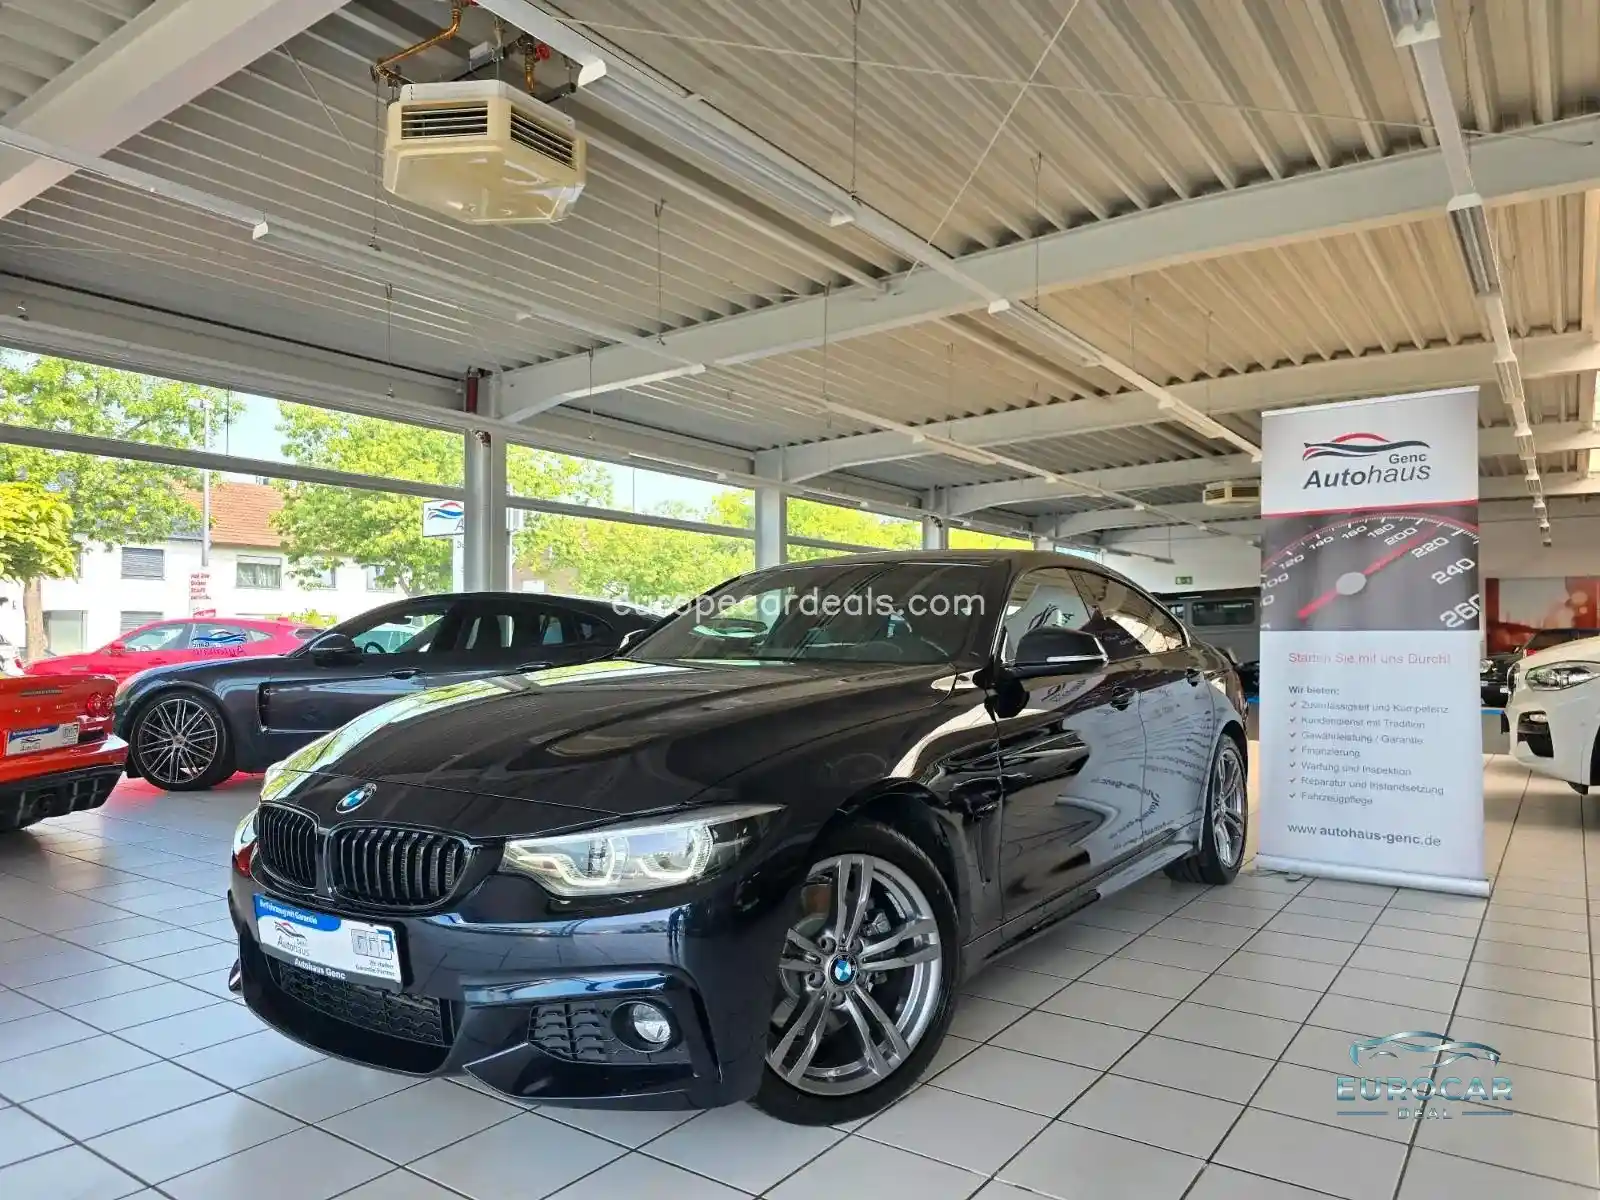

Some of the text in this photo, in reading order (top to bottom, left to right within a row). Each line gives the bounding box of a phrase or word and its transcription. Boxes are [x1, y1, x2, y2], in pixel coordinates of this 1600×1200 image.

[1389, 452, 1427, 465] Genc
[1303, 463, 1432, 490] Autohaus
[1308, 535, 1335, 551] 140
[1384, 526, 1418, 546] 200
[1411, 536, 1451, 560] 220
[1278, 553, 1305, 570] 120
[1431, 557, 1476, 586] 240
[1288, 652, 1451, 664] Starten Sie mit uns Durch!
[1288, 685, 1340, 696] Wir bieten:
[1372, 702, 1391, 712] und
[1301, 716, 1426, 729] Kundendienst mit Tradition
[1381, 734, 1424, 745] Garantie
[1301, 746, 1361, 758] Finanzierung
[1301, 761, 1412, 777] Wartung und Inspektion
[1301, 776, 1444, 797] Reparatur und Instandsetzung
[1301, 791, 1373, 806] Fahrzeugpflege
[294, 957, 347, 980] Autohaus Genc
